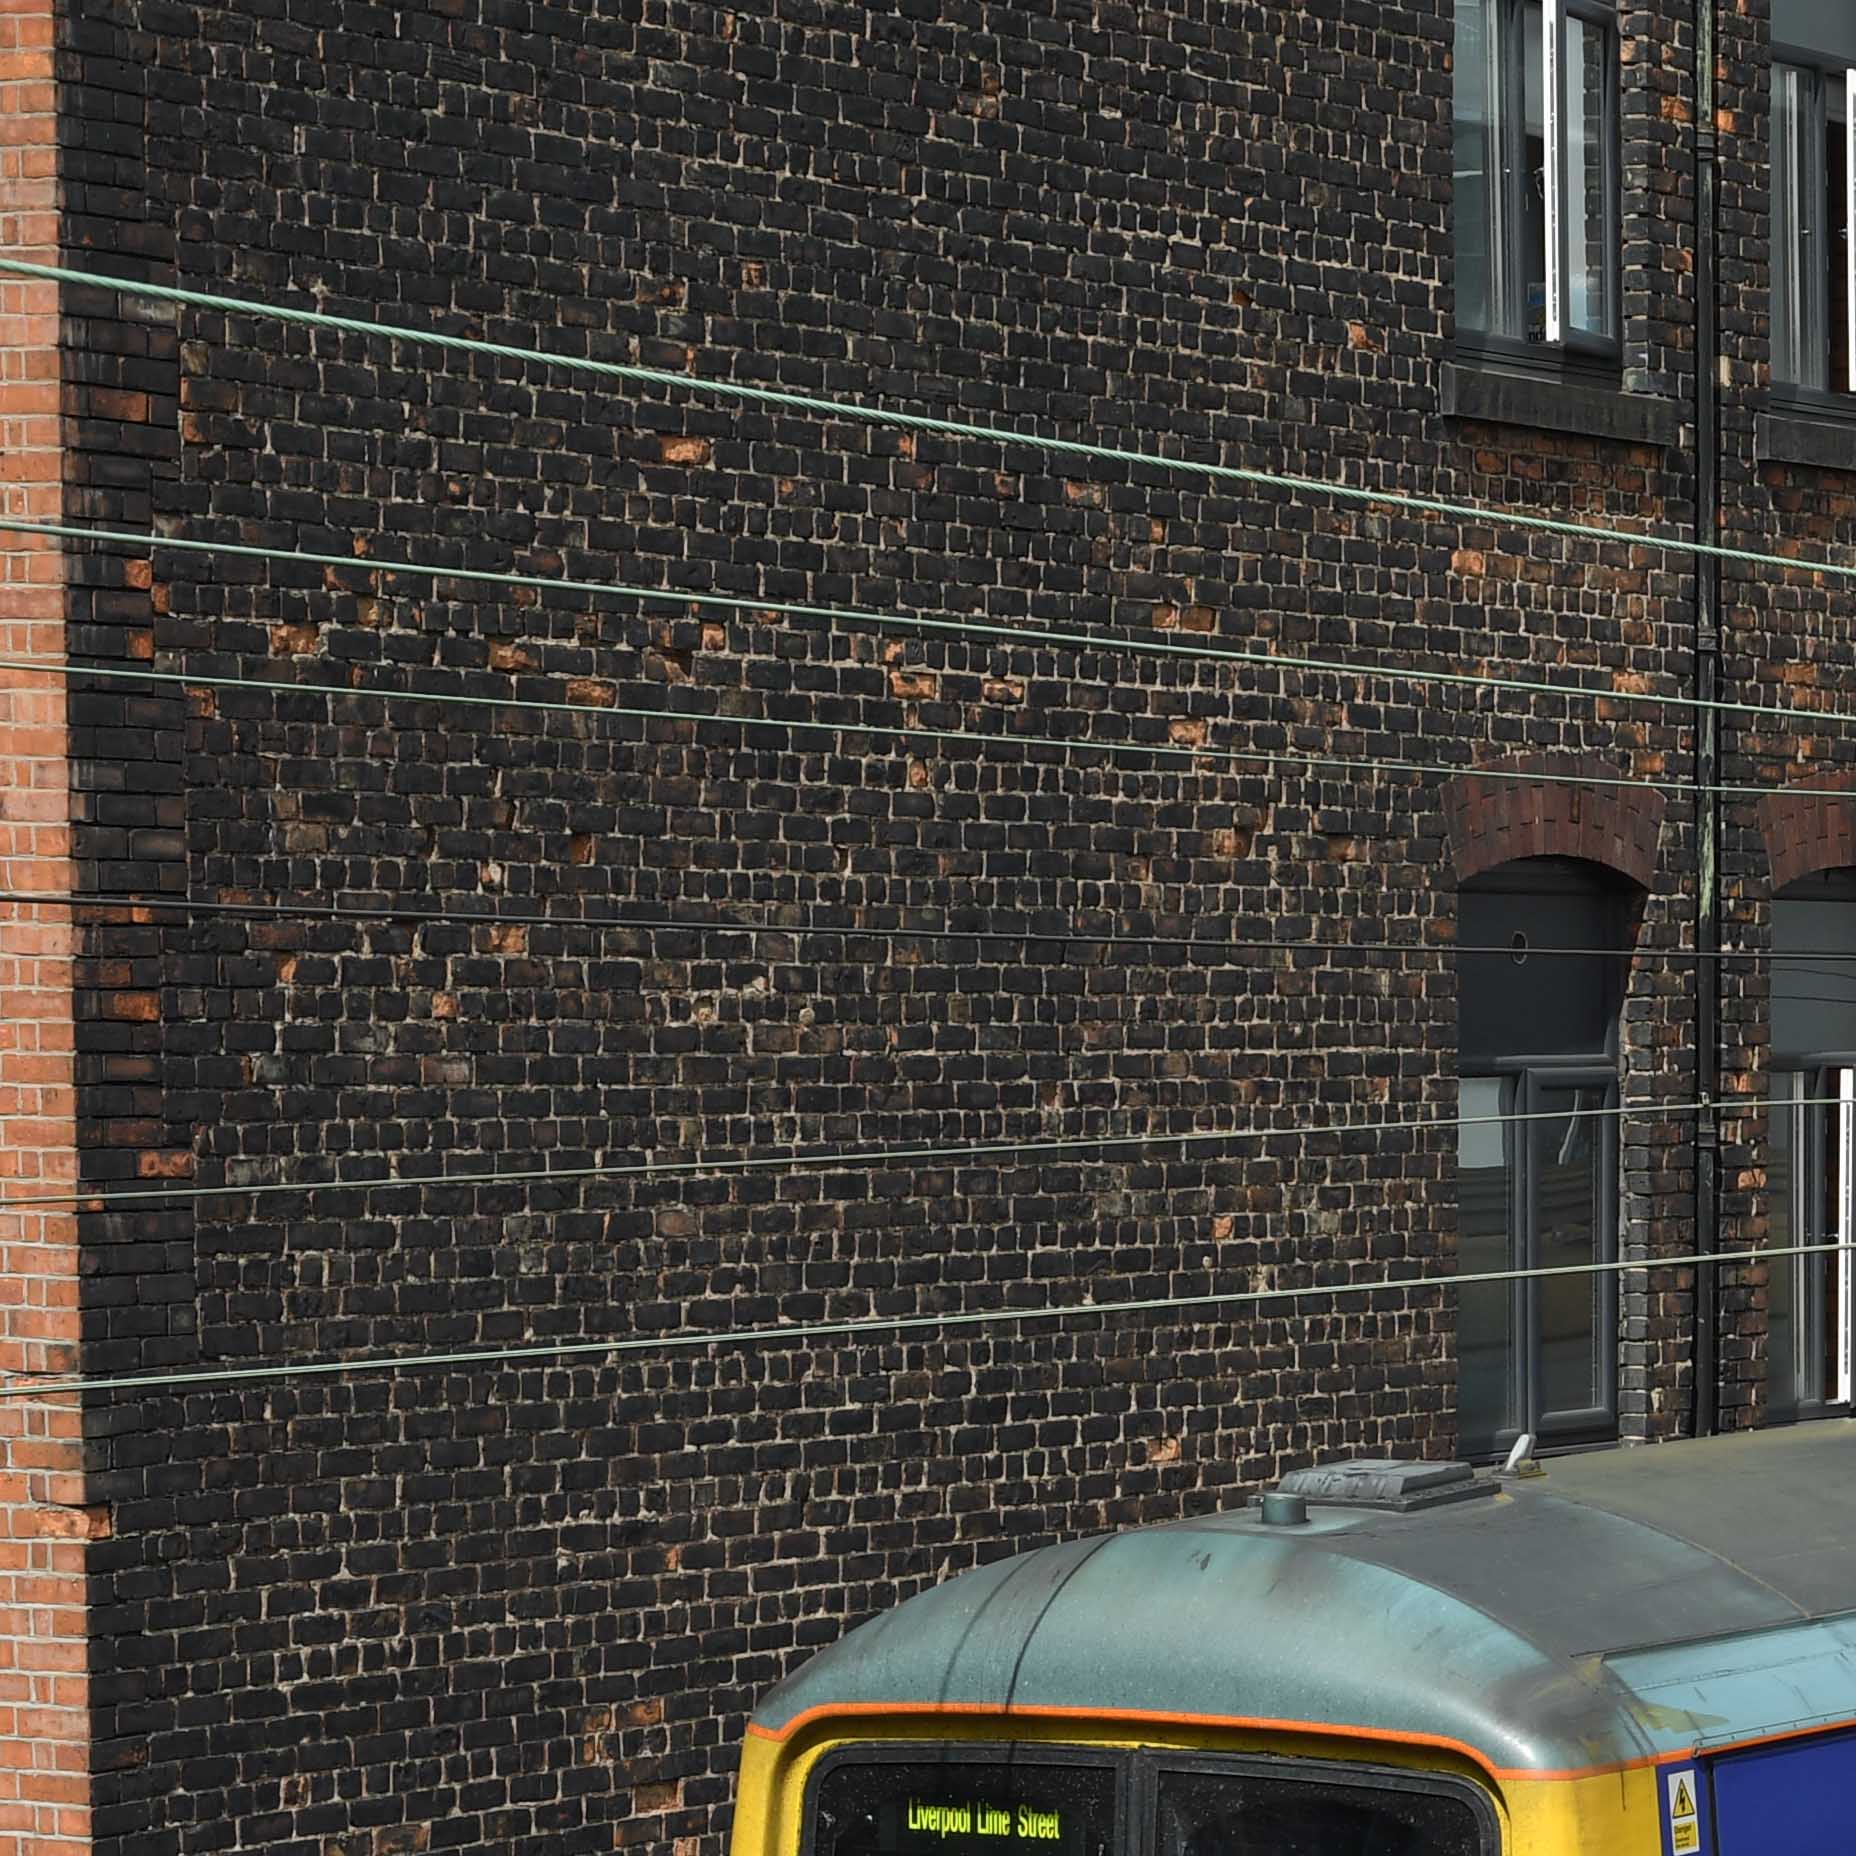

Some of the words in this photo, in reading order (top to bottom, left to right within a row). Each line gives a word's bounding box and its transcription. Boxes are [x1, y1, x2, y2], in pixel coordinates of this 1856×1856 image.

[908, 1798, 971, 1839] Liverpool
[977, 1801, 1010, 1836] Lime
[1018, 1803, 1060, 1840] Street
